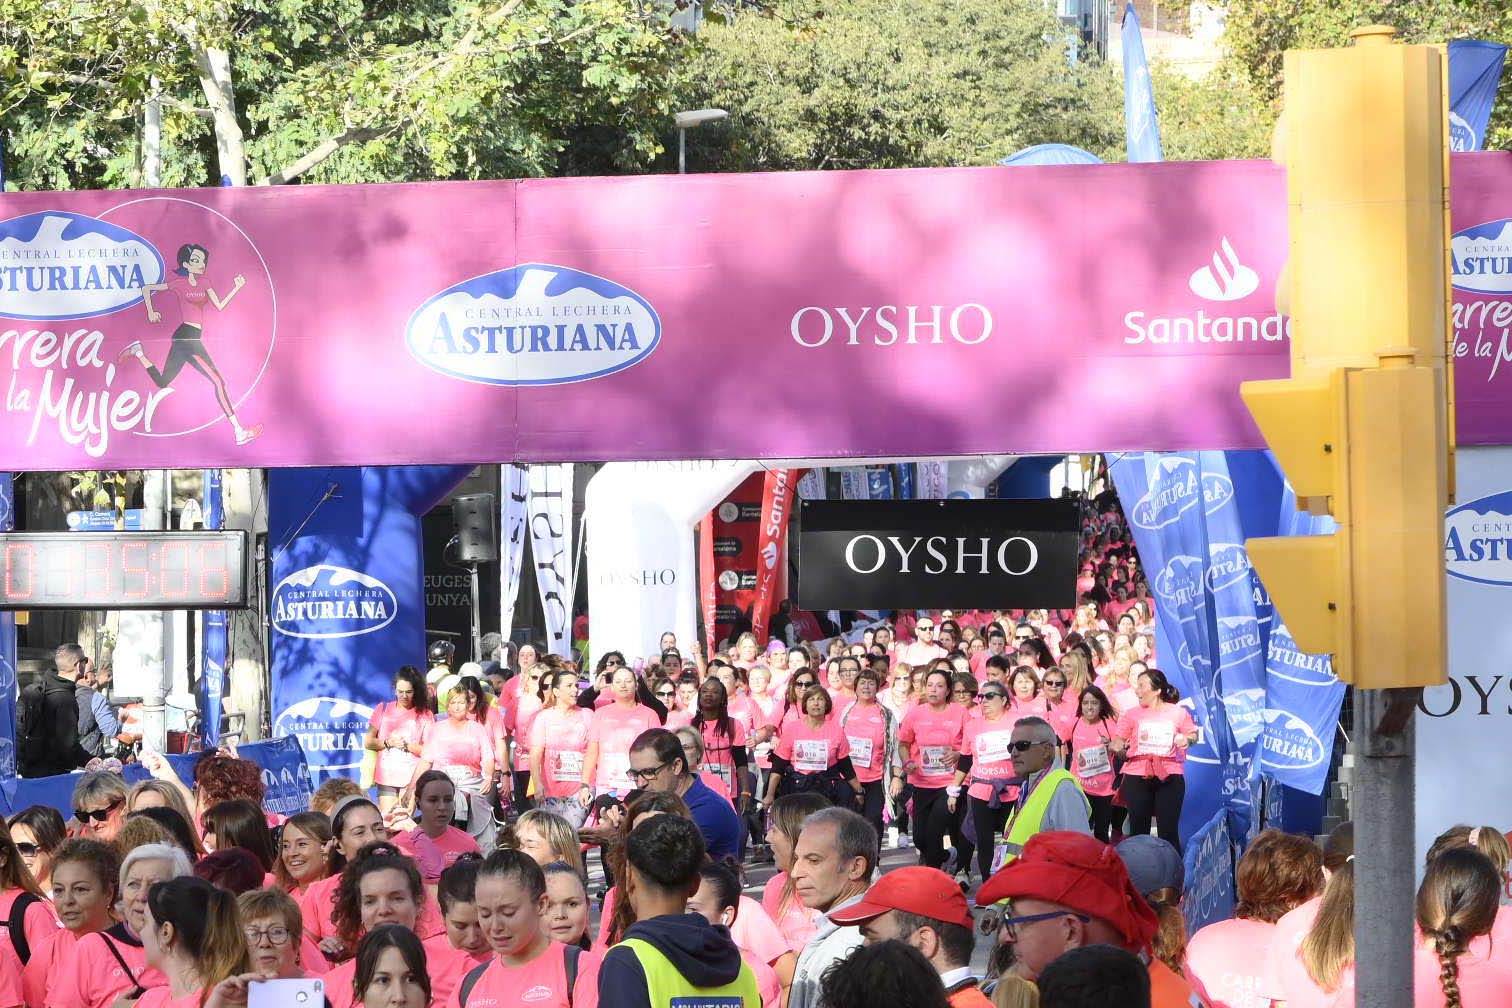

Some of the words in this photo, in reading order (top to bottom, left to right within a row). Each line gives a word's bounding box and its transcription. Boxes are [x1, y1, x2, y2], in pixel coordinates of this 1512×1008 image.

[68, 247, 140, 258] LECHERA
[465, 306, 543, 318] CENTRAL
[551, 304, 633, 318] LECHERA
[790, 303, 993, 348] OYSHO
[426, 312, 641, 356] ASTURIANA
[1124, 312, 1291, 344] Santand
[6, 372, 30, 412] la
[26, 361, 176, 458] Mujer
[844, 533, 1039, 576] OYSHO
[288, 589, 331, 601] CENTRAL
[334, 589, 383, 600] LECHERA
[424, 575, 472, 588] EUGES
[274, 595, 388, 623] ASTURIANA
